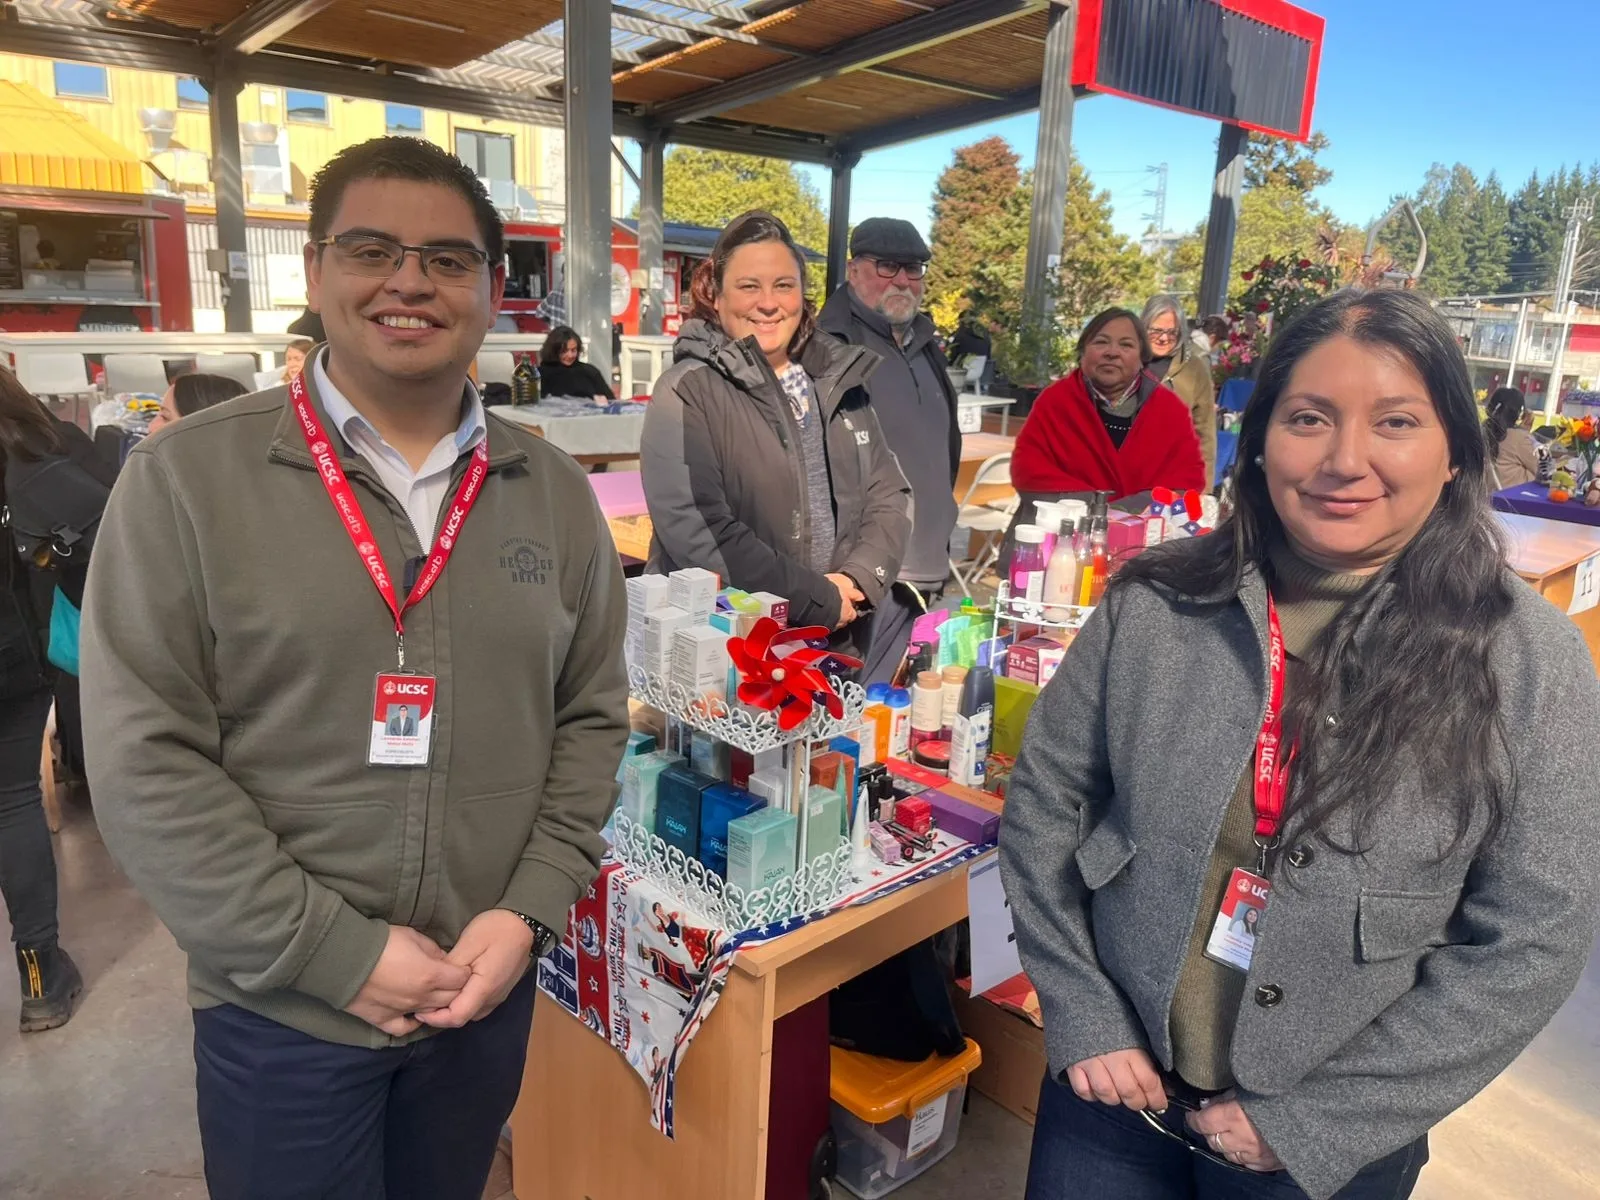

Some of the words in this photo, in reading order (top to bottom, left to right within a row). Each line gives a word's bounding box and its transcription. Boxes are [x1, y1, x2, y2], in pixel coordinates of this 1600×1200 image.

[292, 376, 303, 400] CSC
[318, 452, 340, 486] UCSC
[445, 505, 465, 537] UCSC
[367, 555, 389, 588] UCSC
[1270, 636, 1281, 672] UCSC
[397, 683, 429, 695] UCSC
[1260, 747, 1275, 783] UCSC
[1251, 884, 1268, 900] UC
[608, 918, 618, 954] CHILE
[613, 1009, 623, 1042] CHILE
